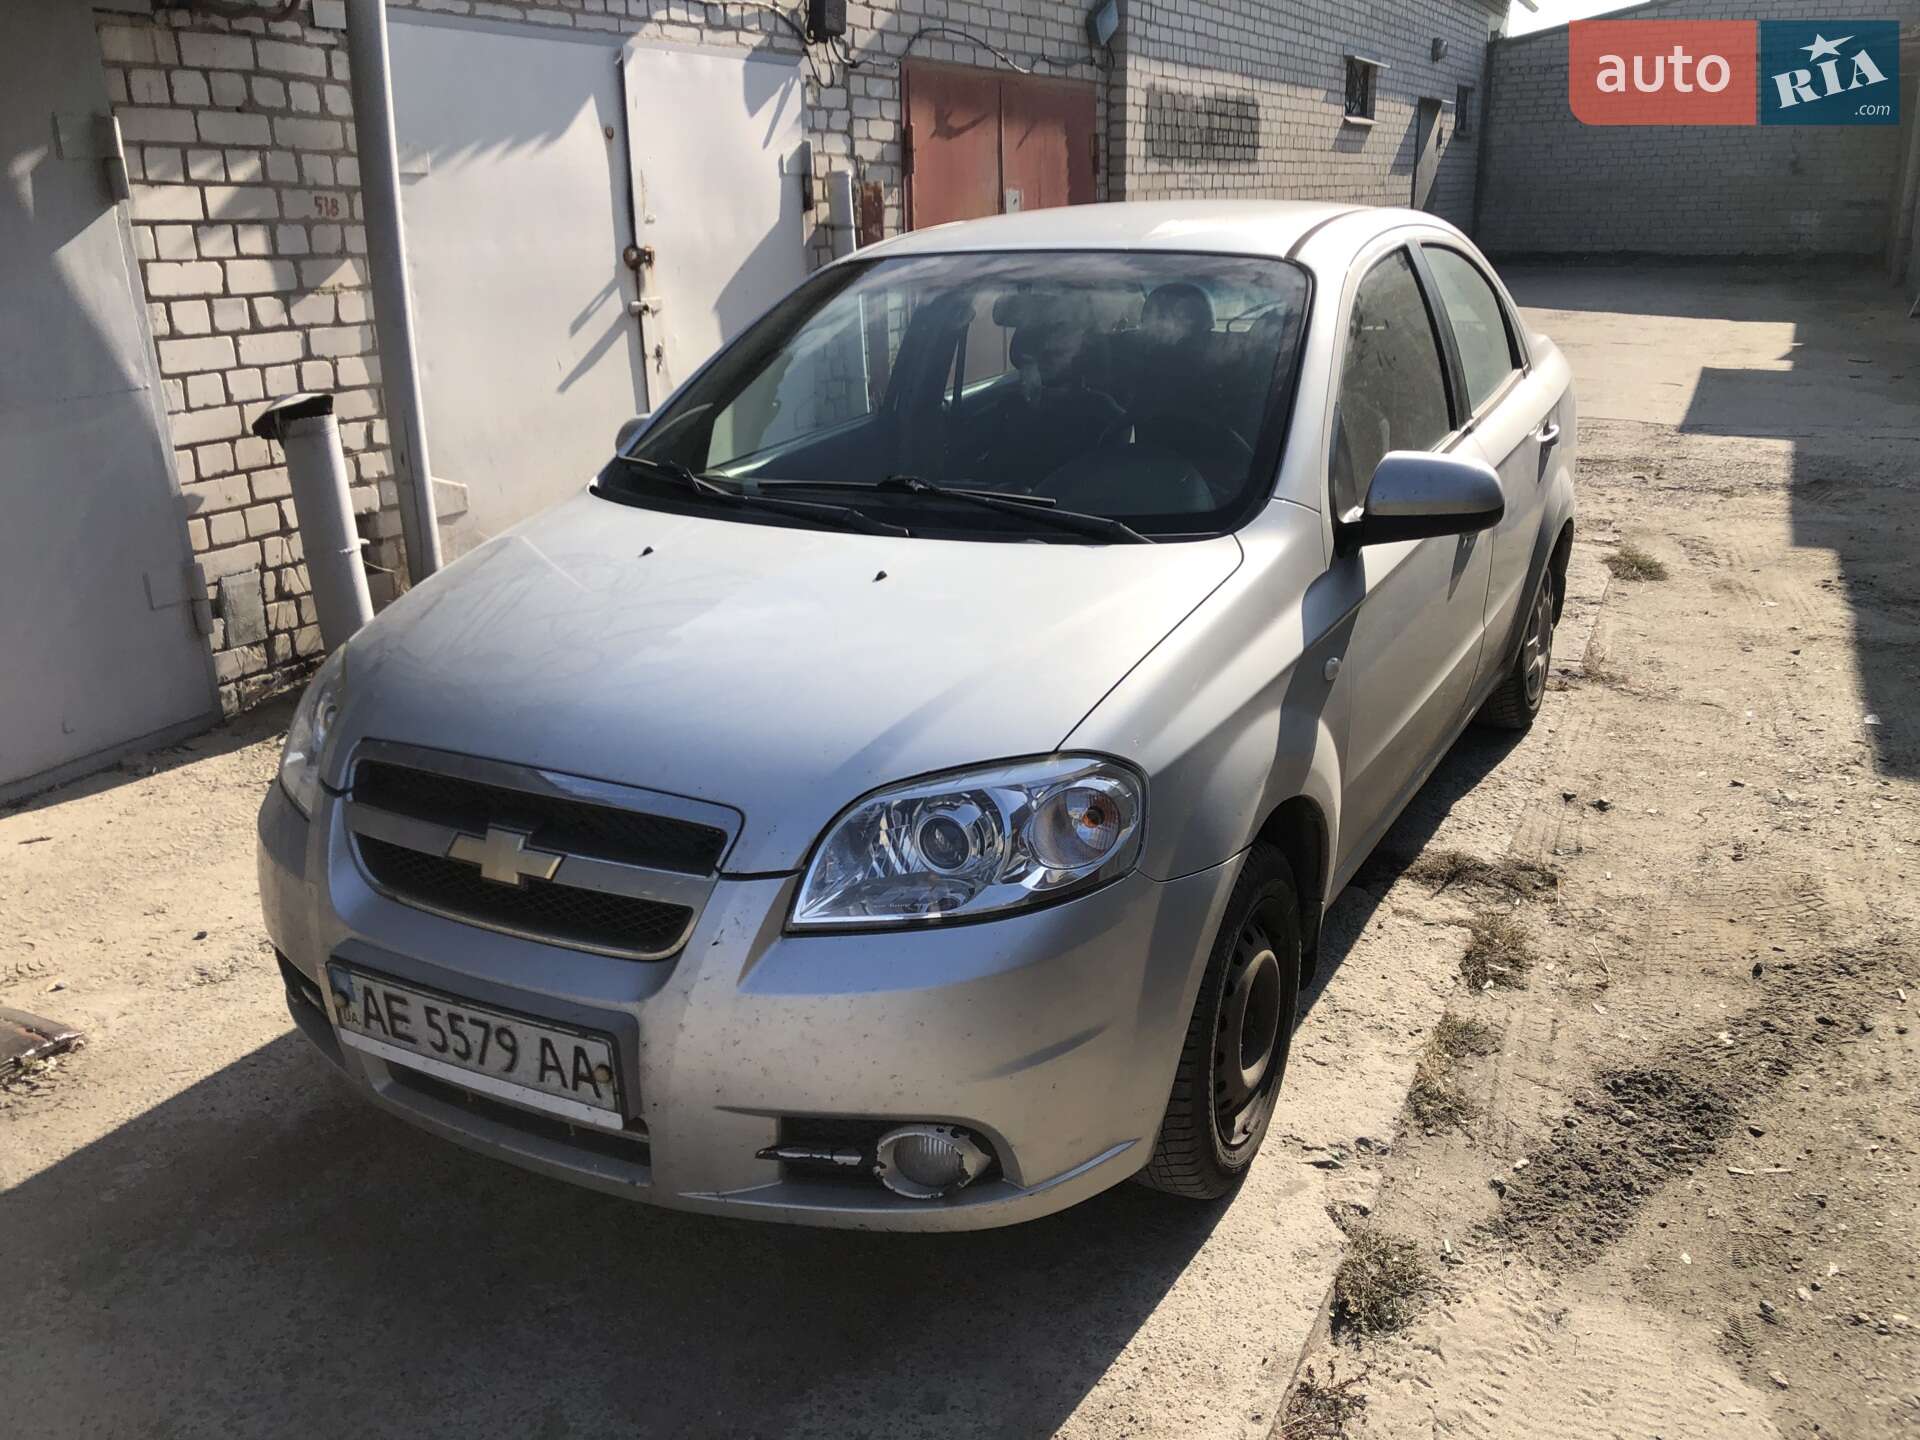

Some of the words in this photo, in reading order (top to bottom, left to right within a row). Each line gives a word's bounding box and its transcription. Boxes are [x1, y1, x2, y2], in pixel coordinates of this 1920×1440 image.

[363, 984, 418, 1045] AE
[423, 1005, 519, 1073] 5579
[539, 1036, 602, 1099] AA
